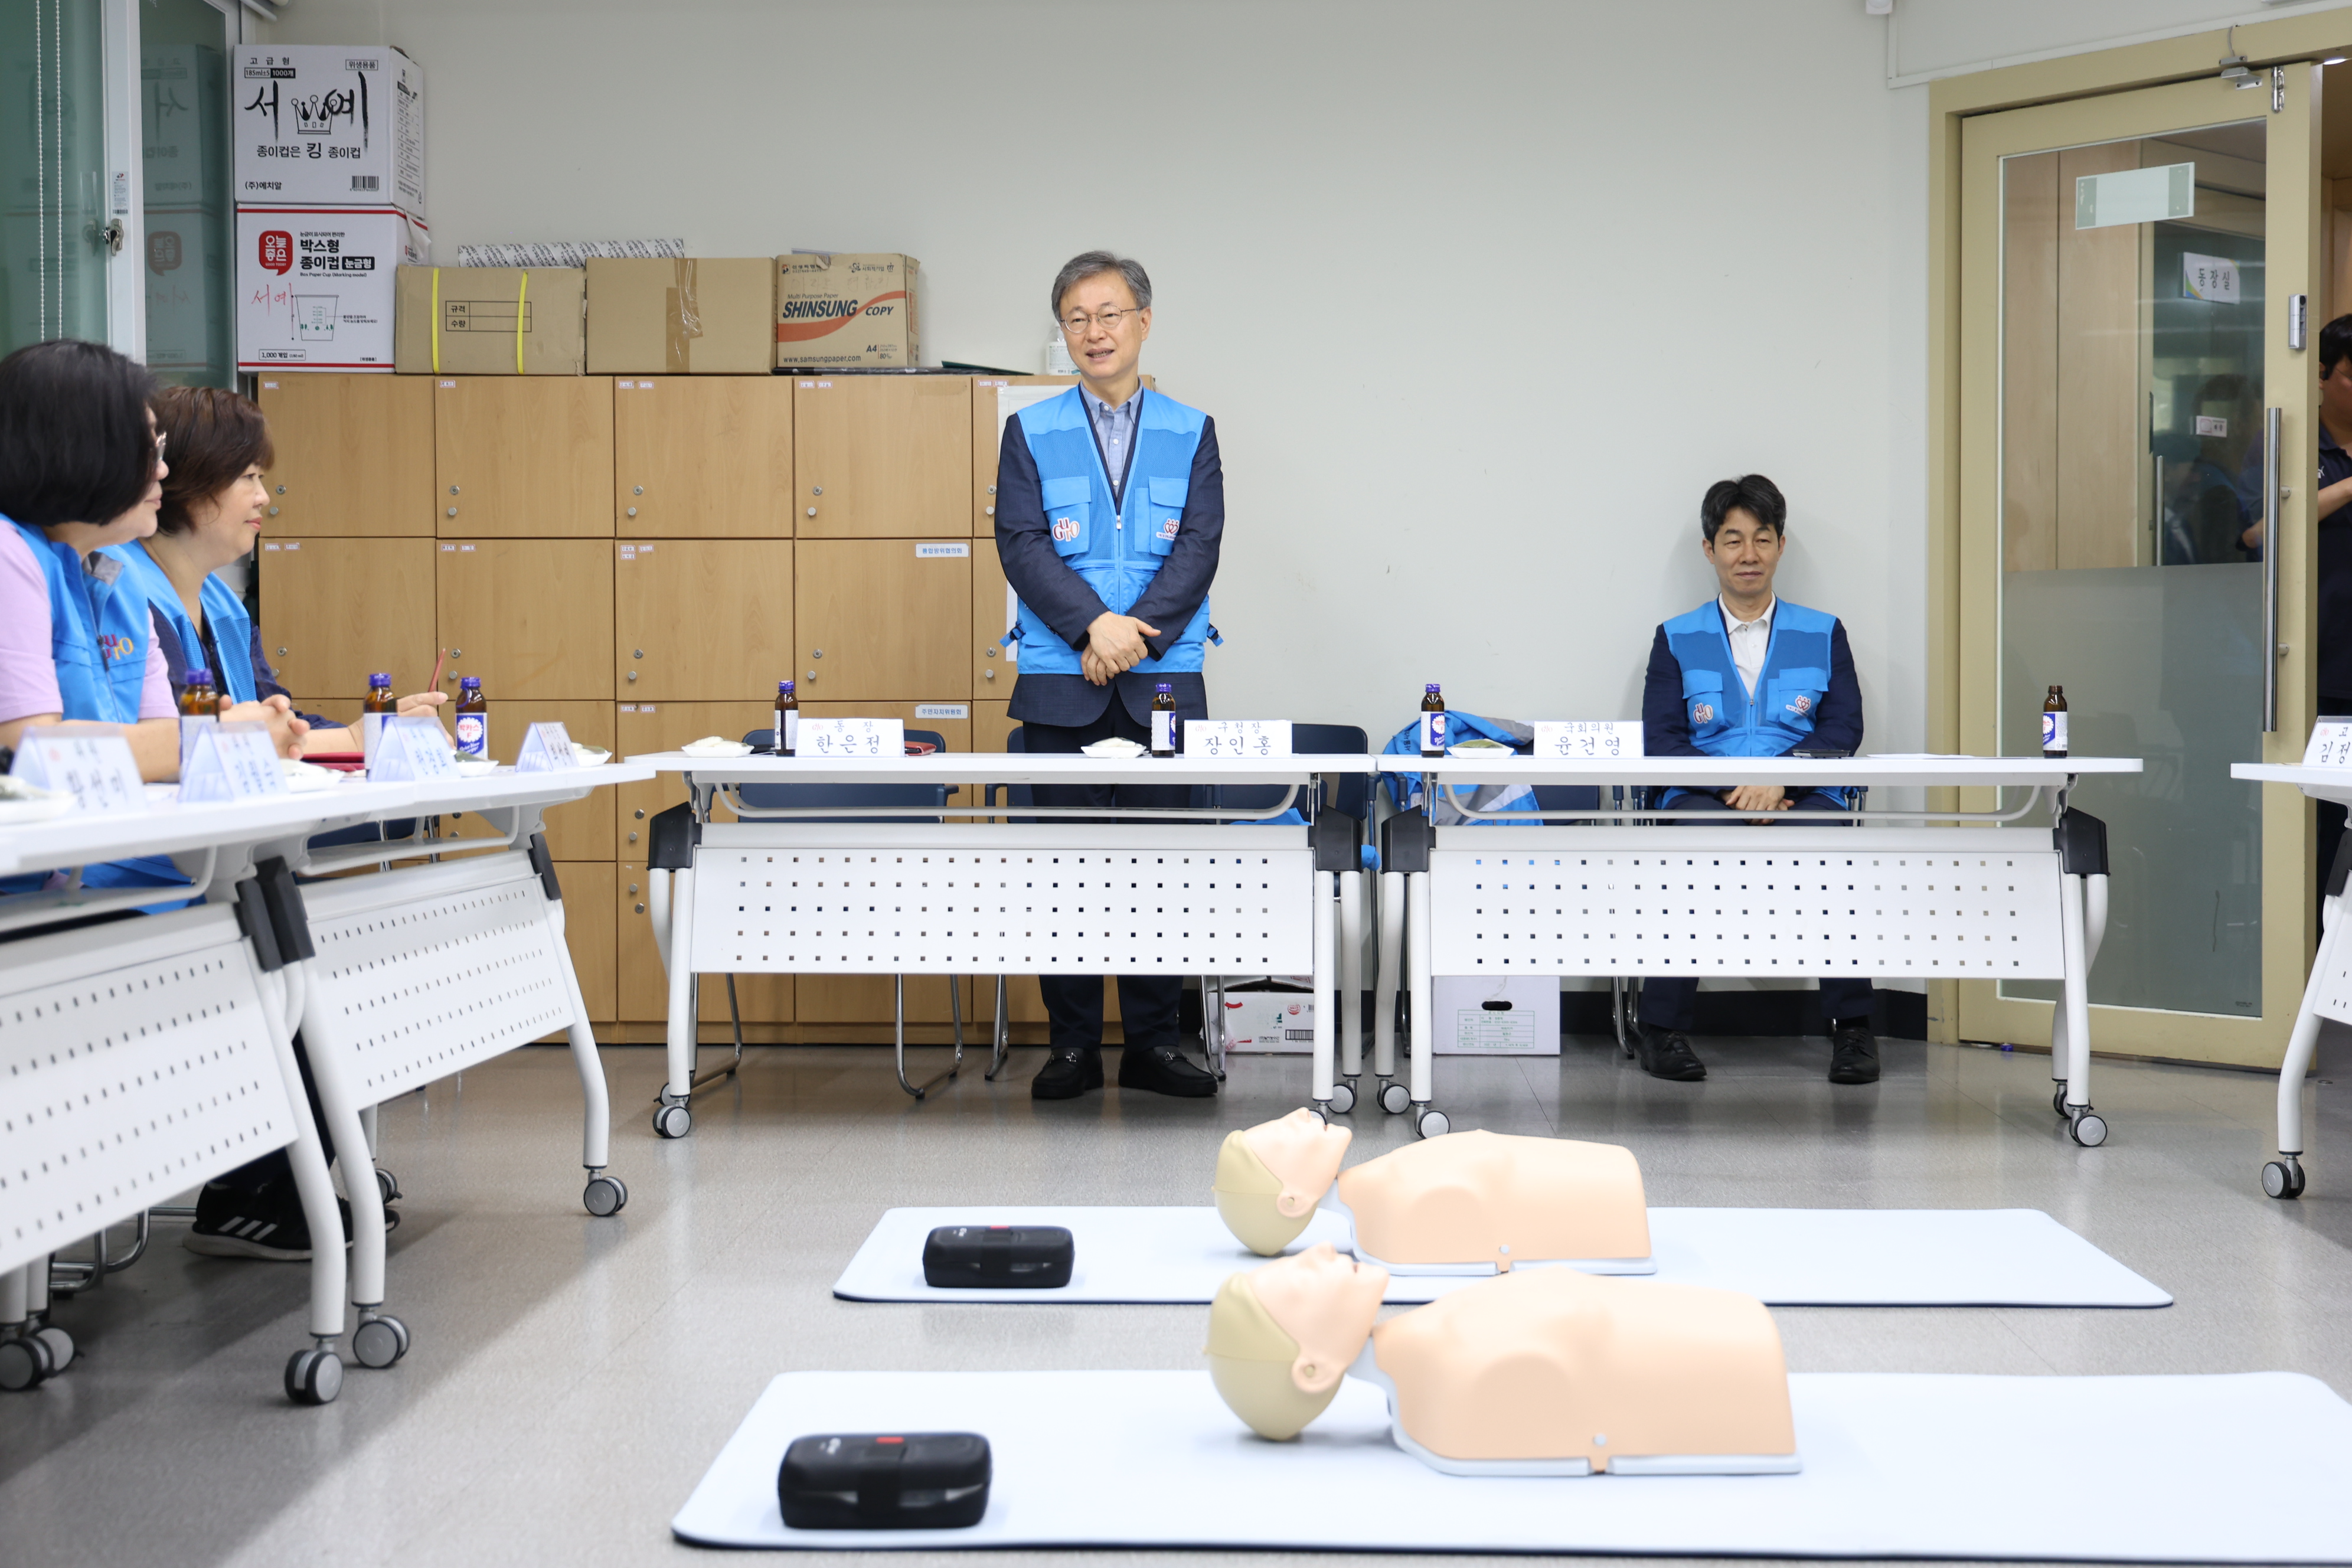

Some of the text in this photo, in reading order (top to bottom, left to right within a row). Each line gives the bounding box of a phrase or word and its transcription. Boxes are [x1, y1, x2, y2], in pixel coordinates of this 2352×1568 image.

[349, 61, 375, 69] 위생용품
[257, 143, 361, 158] 종이컵은 킹 종이컵
[245, 181, 282, 190] (주)에치알
[300, 239, 339, 253] 박스형
[300, 256, 371, 270] 종이컵 눈금형
[2198, 268, 2230, 290] 동장실
[783, 299, 858, 318] SHINSUNG
[865, 306, 894, 316] COPY
[451, 319, 465, 328] 수량
